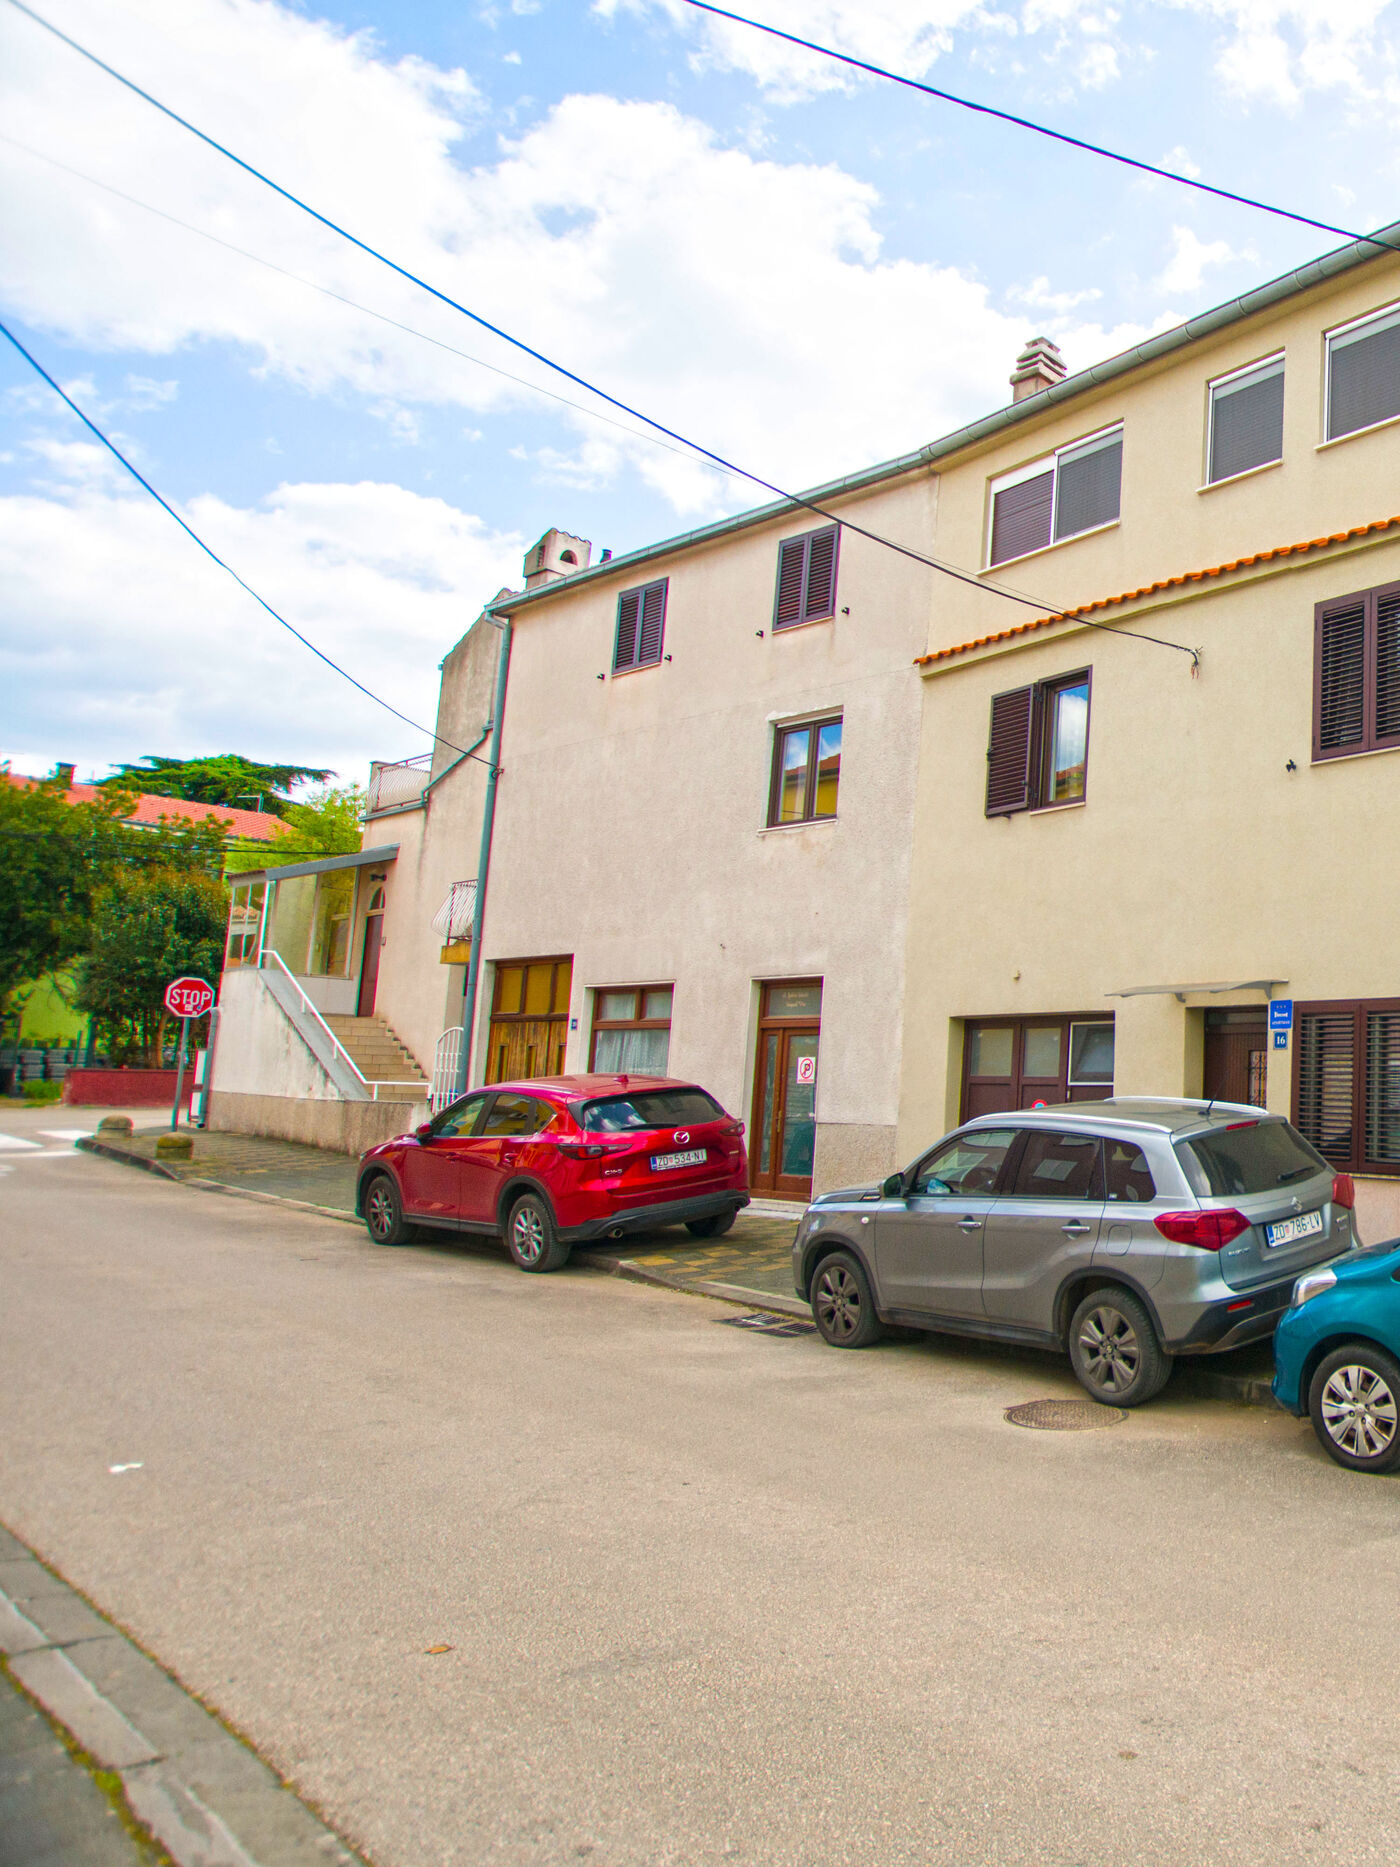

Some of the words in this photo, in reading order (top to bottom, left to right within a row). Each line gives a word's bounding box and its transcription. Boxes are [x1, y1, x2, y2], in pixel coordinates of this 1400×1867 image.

[171, 989, 211, 1006] STOP
[1277, 1036, 1286, 1045] 16
[657, 1156, 669, 1167] ZD
[1273, 1223, 1286, 1241] ZD
